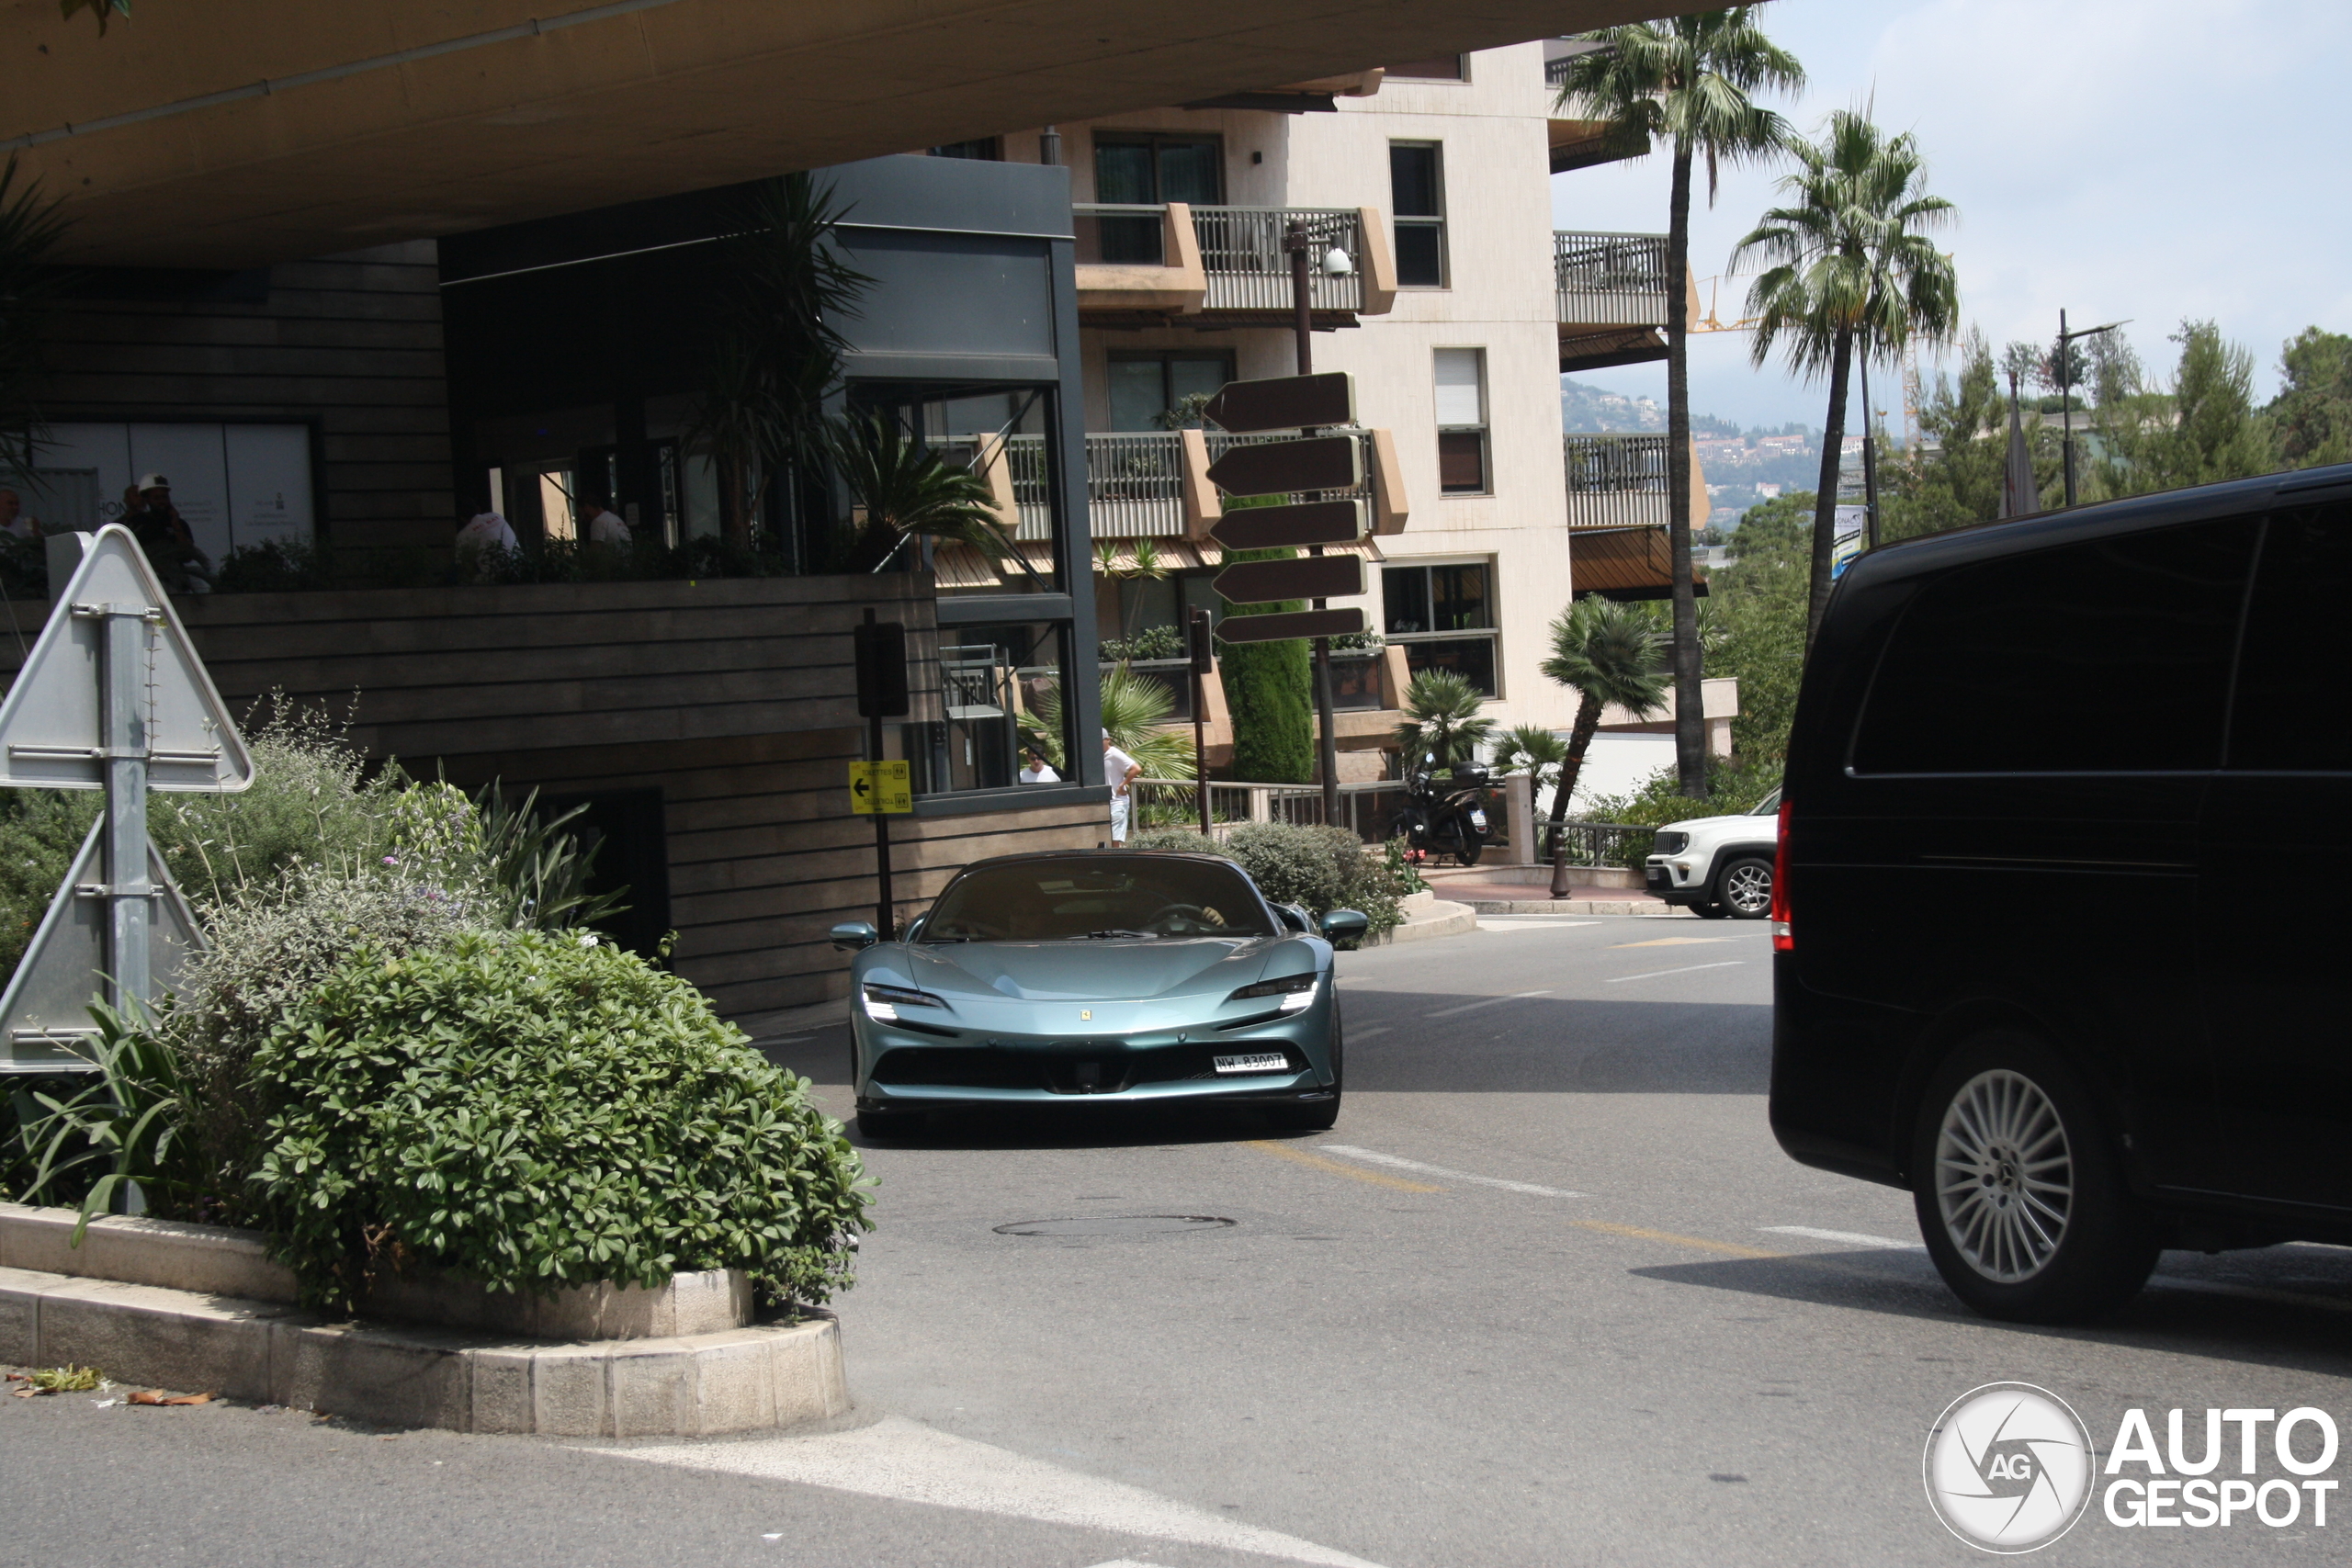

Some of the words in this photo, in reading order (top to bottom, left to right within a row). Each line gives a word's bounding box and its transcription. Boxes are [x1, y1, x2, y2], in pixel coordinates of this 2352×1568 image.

[862, 768, 892, 776] TOILETTES
[1216, 1057, 1235, 1069] NW
[1243, 1055, 1281, 1068] 83007
